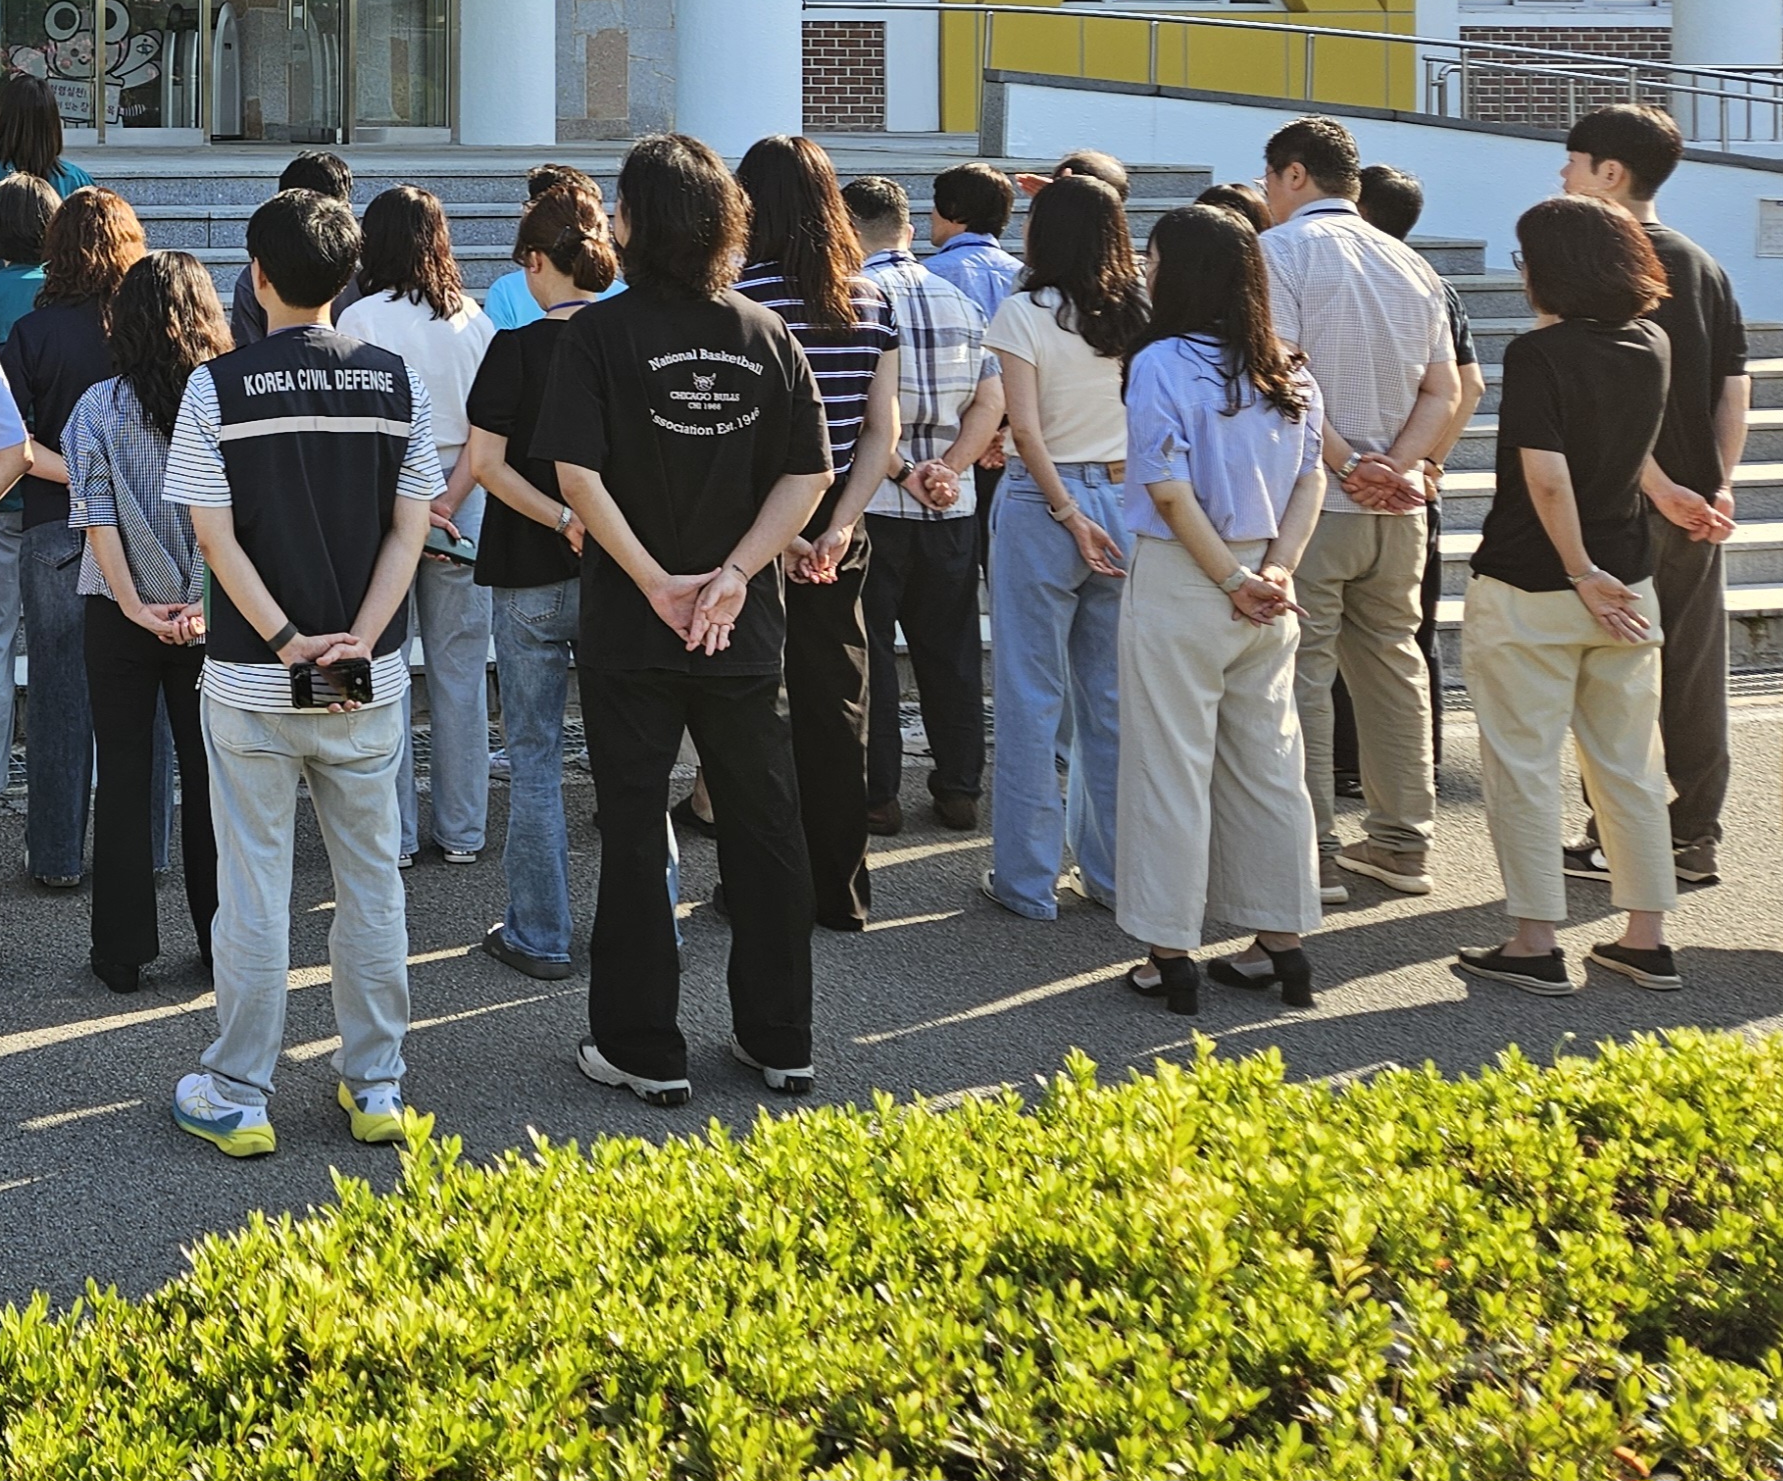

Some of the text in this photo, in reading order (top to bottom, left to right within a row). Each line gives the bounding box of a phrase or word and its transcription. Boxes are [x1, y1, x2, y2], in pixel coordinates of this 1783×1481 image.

[647, 348, 764, 376] National Basketball
[242, 369, 395, 396] KOREA CIVIL DEFENSE
[669, 391, 741, 402] CHICAGO BULLS
